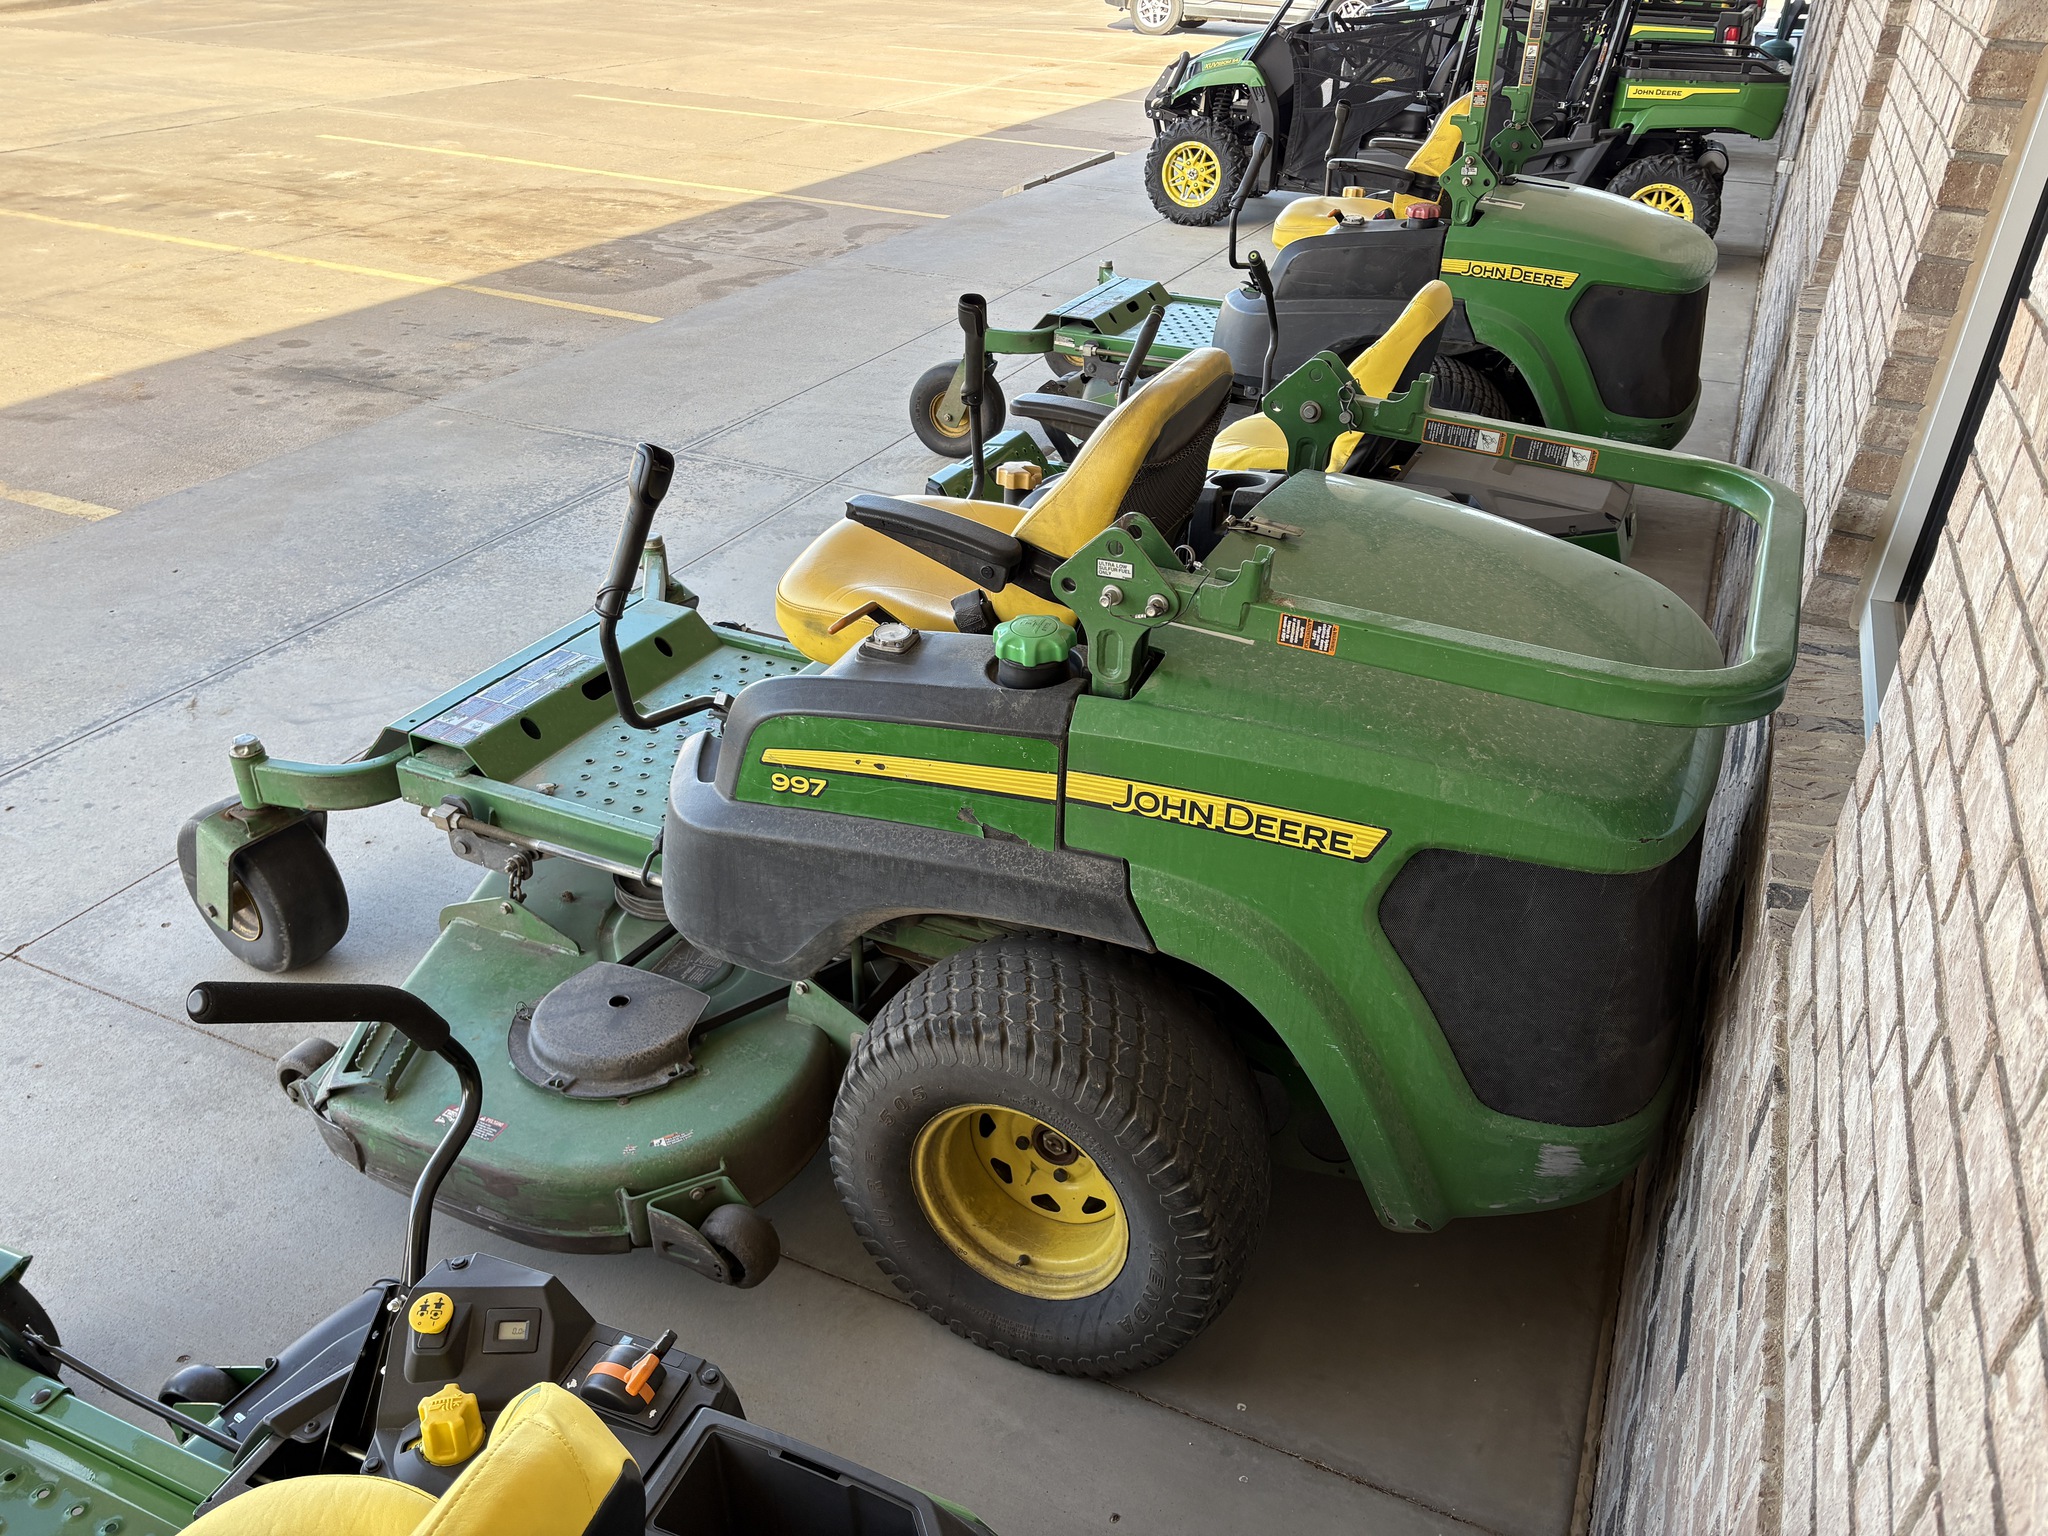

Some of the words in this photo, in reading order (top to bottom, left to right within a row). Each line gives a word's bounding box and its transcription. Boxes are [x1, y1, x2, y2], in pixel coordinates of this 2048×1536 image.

[1461, 262, 1506, 279] JOHN
[1510, 267, 1565, 286] DEERE
[771, 772, 827, 797] 997
[1112, 784, 1214, 825] JOHN
[1224, 803, 1354, 854] DEERE
[879, 1085, 927, 1127] 505
[864, 1151, 908, 1251] TURF
[1117, 1241, 1168, 1336] KENDA
